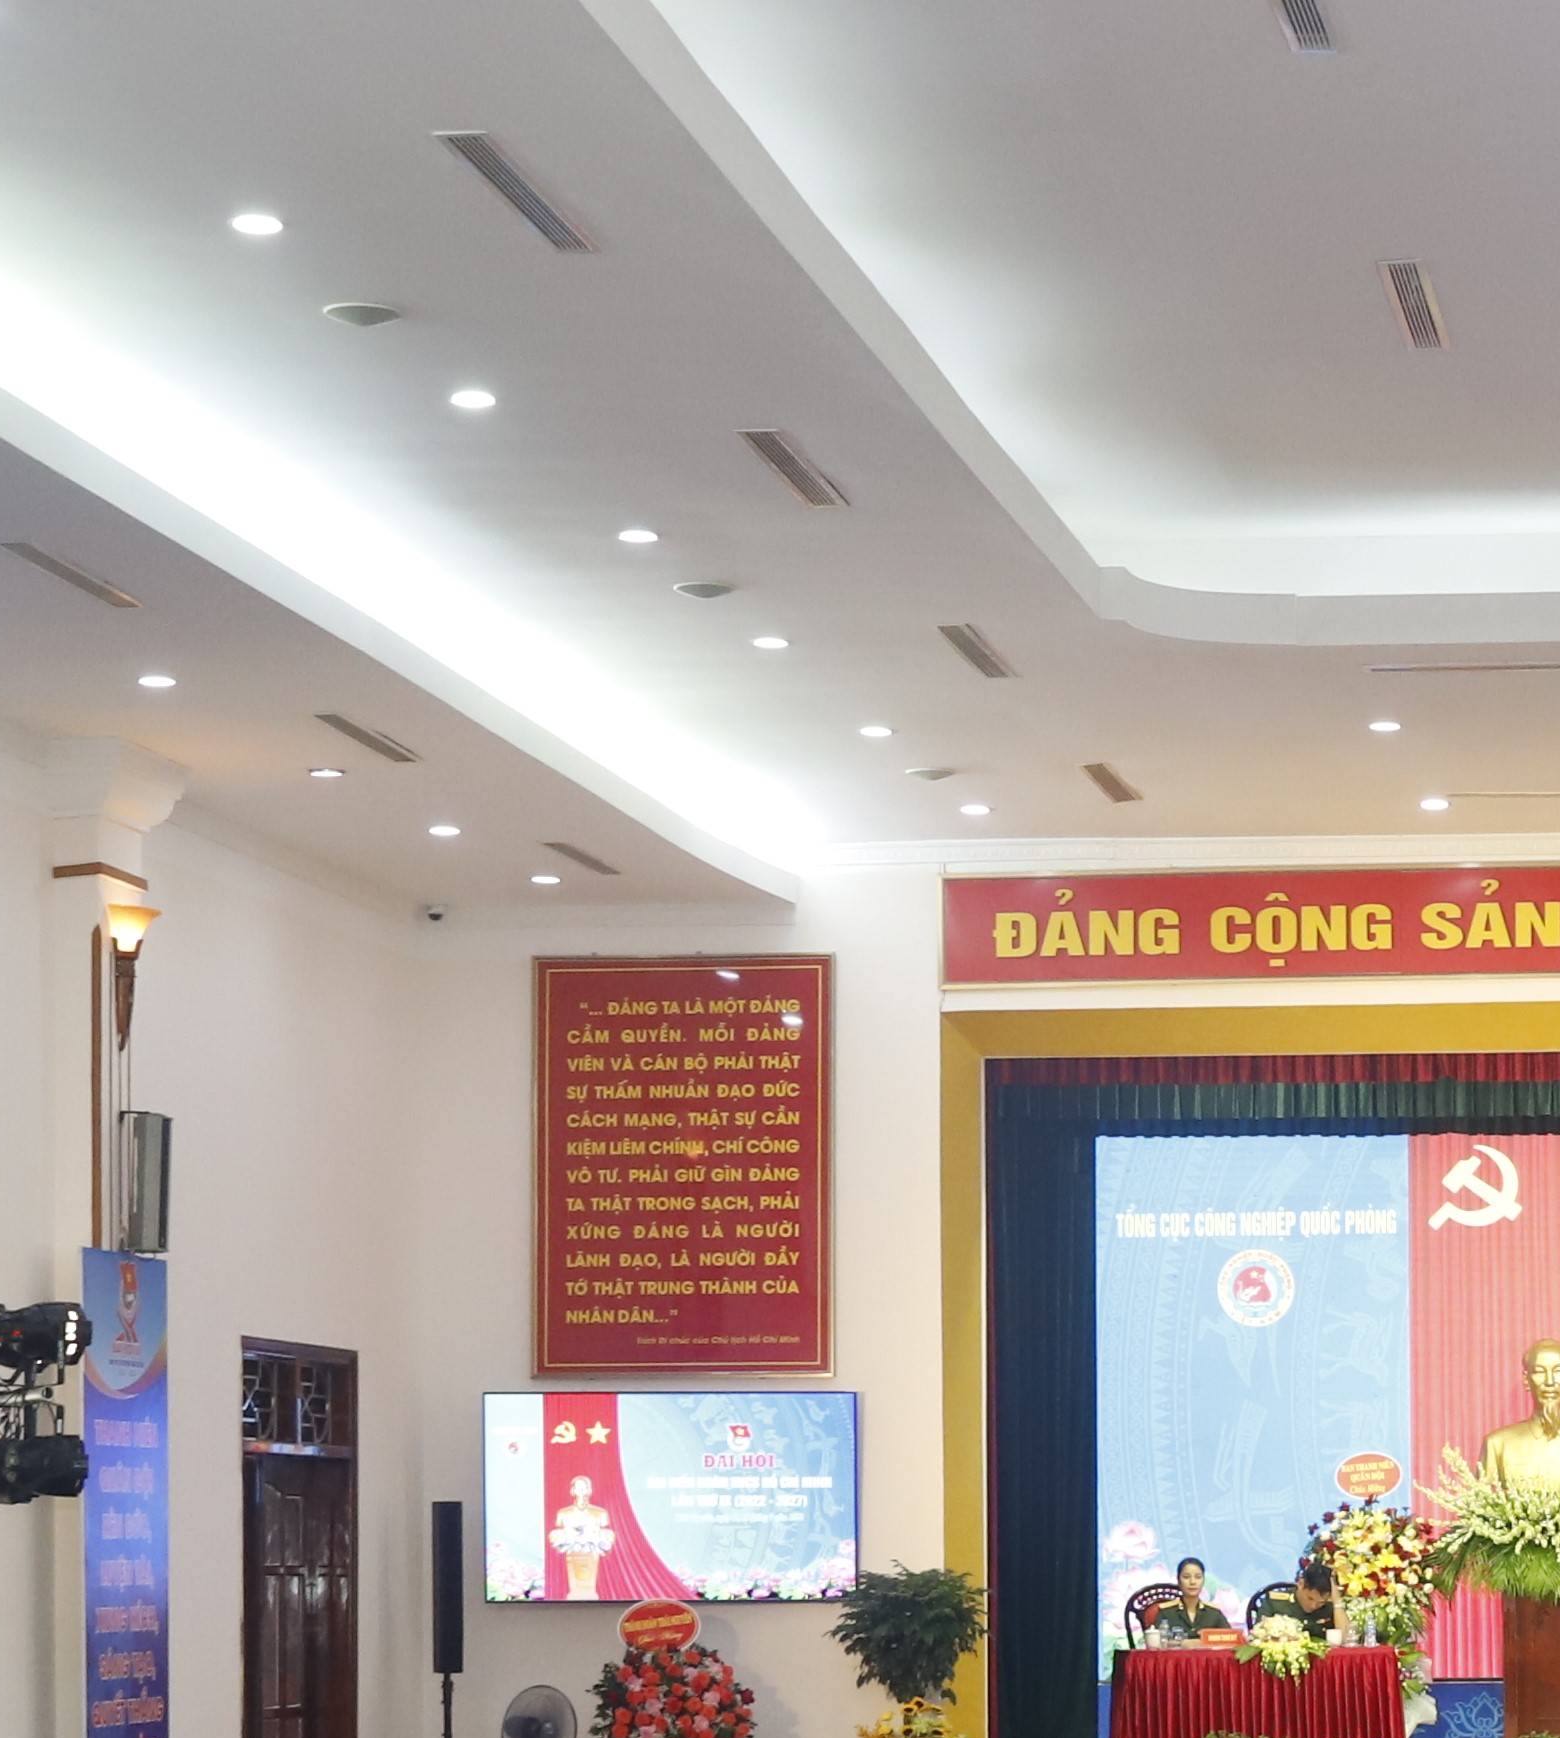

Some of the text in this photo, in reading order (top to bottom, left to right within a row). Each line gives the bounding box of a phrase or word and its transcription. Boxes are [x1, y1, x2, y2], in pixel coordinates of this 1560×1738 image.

[993, 888, 1179, 959] ĐẢNG
[1210, 893, 1393, 967] CỘNG
[1420, 879, 1560, 949] SẢN
[567, 1051, 801, 1074] VIÊN VÀ CÁN BỘ PHẢI THẬT
[1116, 1202, 1397, 1242] TỔNG CỤC CÔNG NGHIỆP QUỐC PHÒNG
